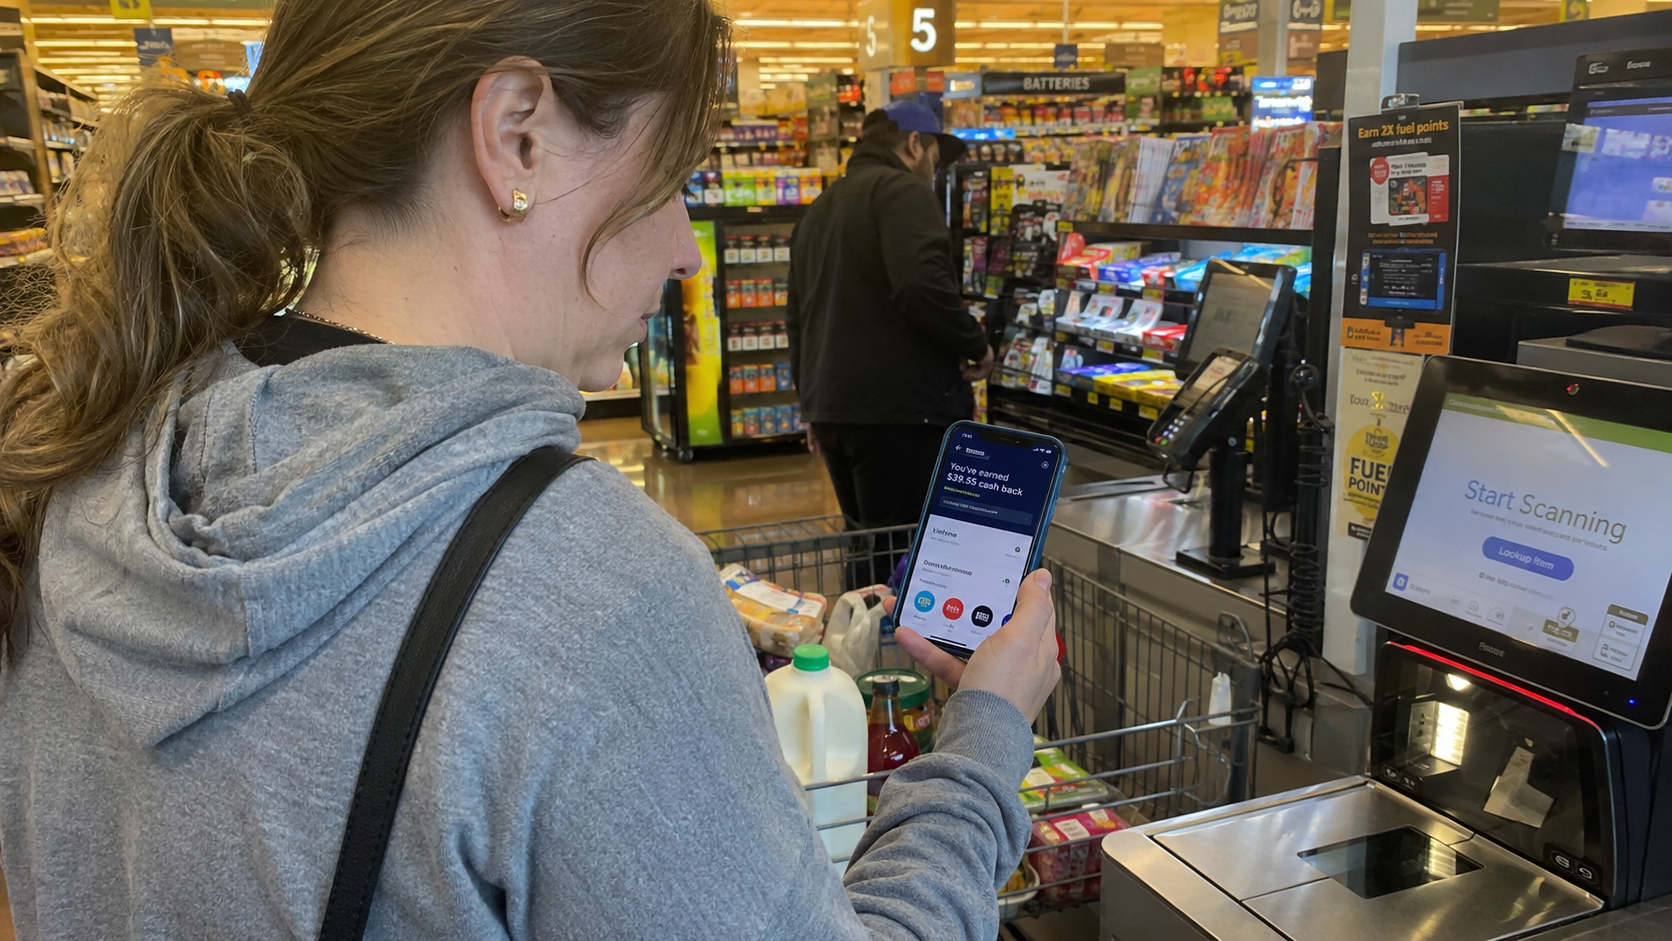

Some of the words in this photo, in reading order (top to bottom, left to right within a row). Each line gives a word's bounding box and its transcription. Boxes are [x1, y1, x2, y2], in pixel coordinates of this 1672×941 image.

[910, 8, 937, 53] 5
[1023, 76, 1090, 91] BATTERIES
[1358, 127, 1379, 139] Earn
[1381, 124, 1394, 136] 2X
[1396, 122, 1415, 135] fuel
[1417, 120, 1449, 135] points
[946, 472, 977, 486] $39.55
[978, 480, 999, 491] cash
[1001, 484, 1023, 497] back
[950, 462, 977, 475] You've
[978, 469, 1010, 482] earned
[1464, 479, 1516, 511] Start
[1519, 493, 1627, 545] Scanning
[1498, 546, 1531, 564] Lookup
[1533, 556, 1554, 571] Item
